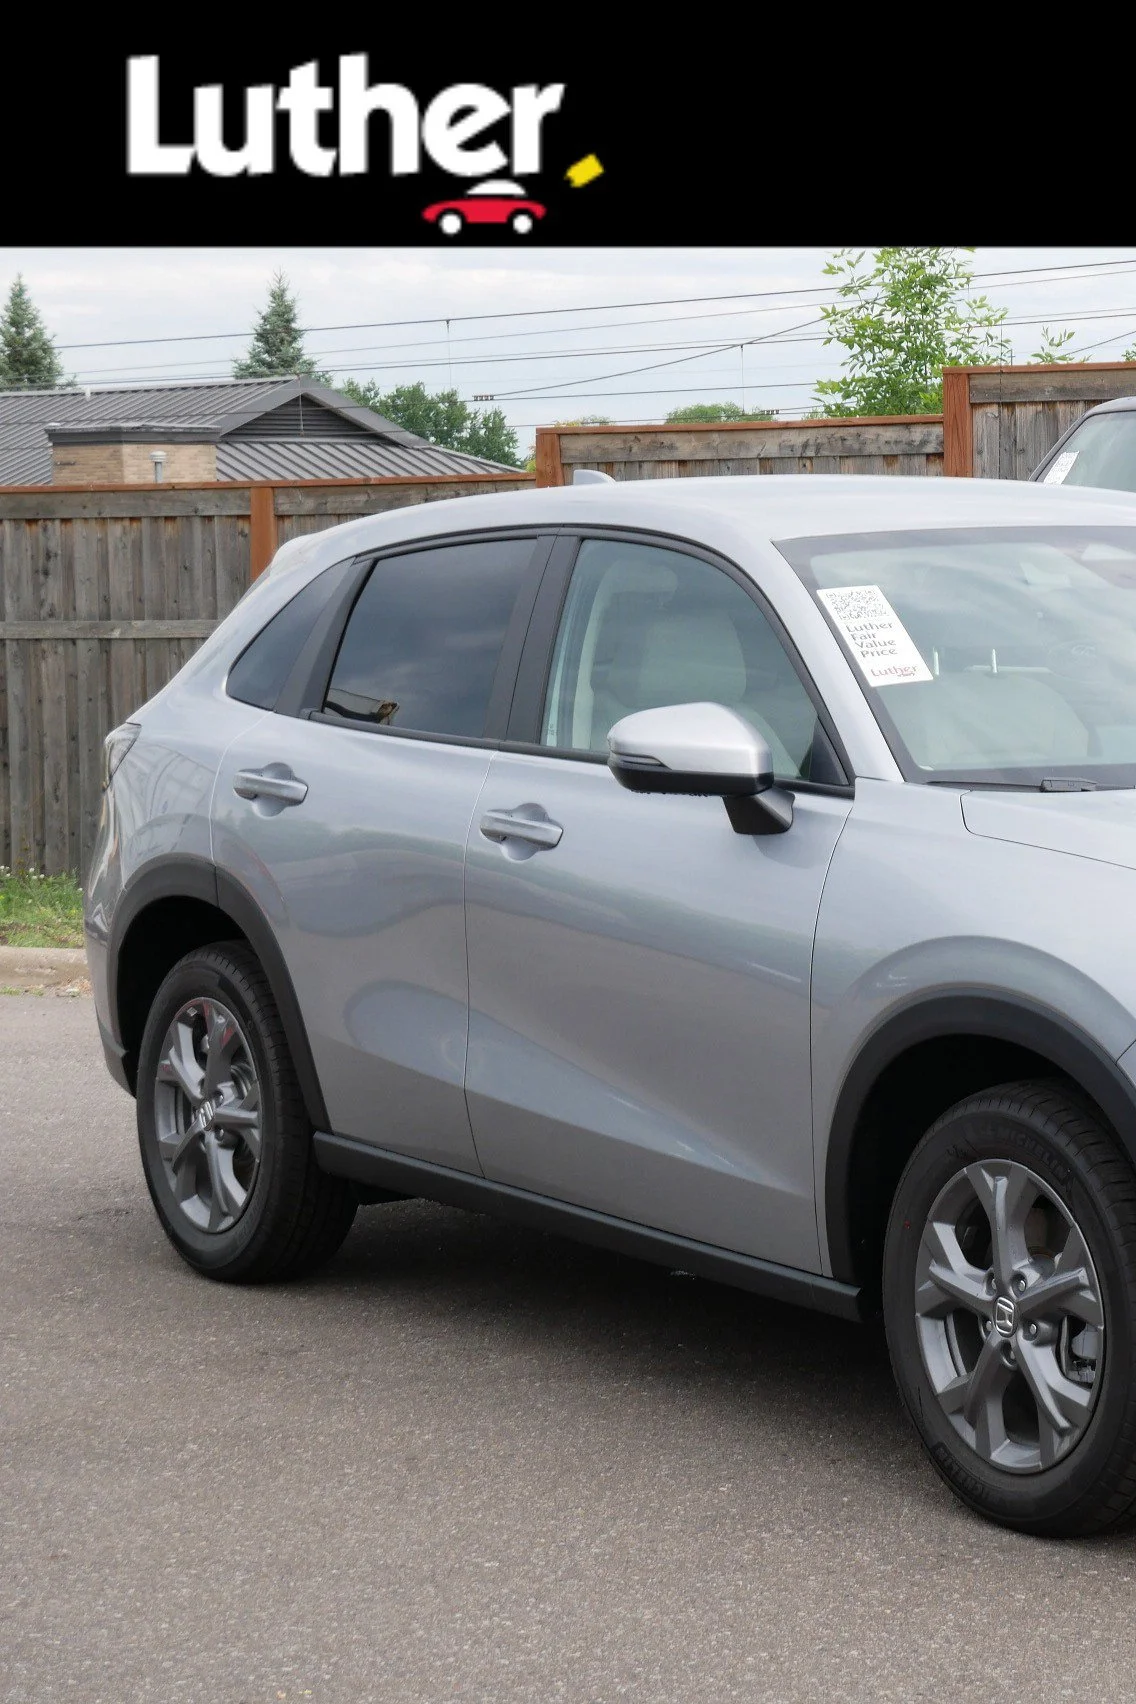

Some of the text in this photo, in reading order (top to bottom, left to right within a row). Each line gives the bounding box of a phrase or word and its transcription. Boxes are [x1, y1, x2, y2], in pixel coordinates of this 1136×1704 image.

[846, 622, 893, 633] Luther
[850, 632, 877, 641] Fair
[855, 639, 897, 649] Value
[860, 648, 898, 658] Price
